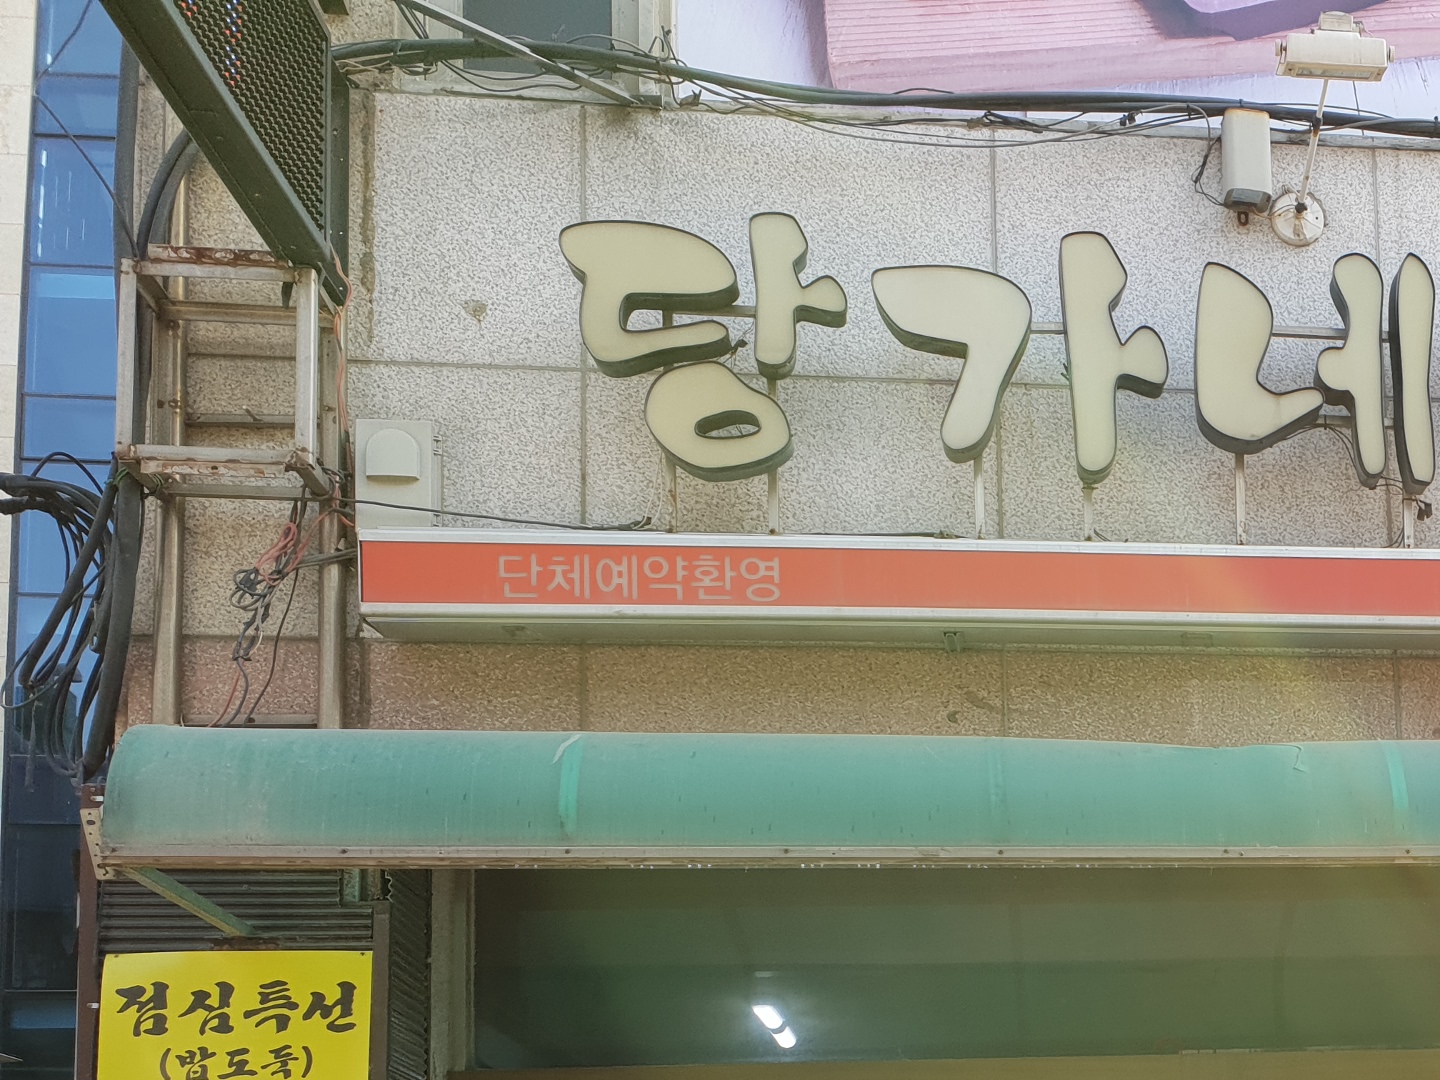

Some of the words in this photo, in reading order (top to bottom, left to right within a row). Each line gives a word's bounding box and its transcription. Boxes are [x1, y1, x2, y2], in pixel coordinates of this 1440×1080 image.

[558, 211, 1436, 495] 당가네
[497, 552, 782, 603] 단체예약환영
[114, 979, 358, 1037] 점심특선
